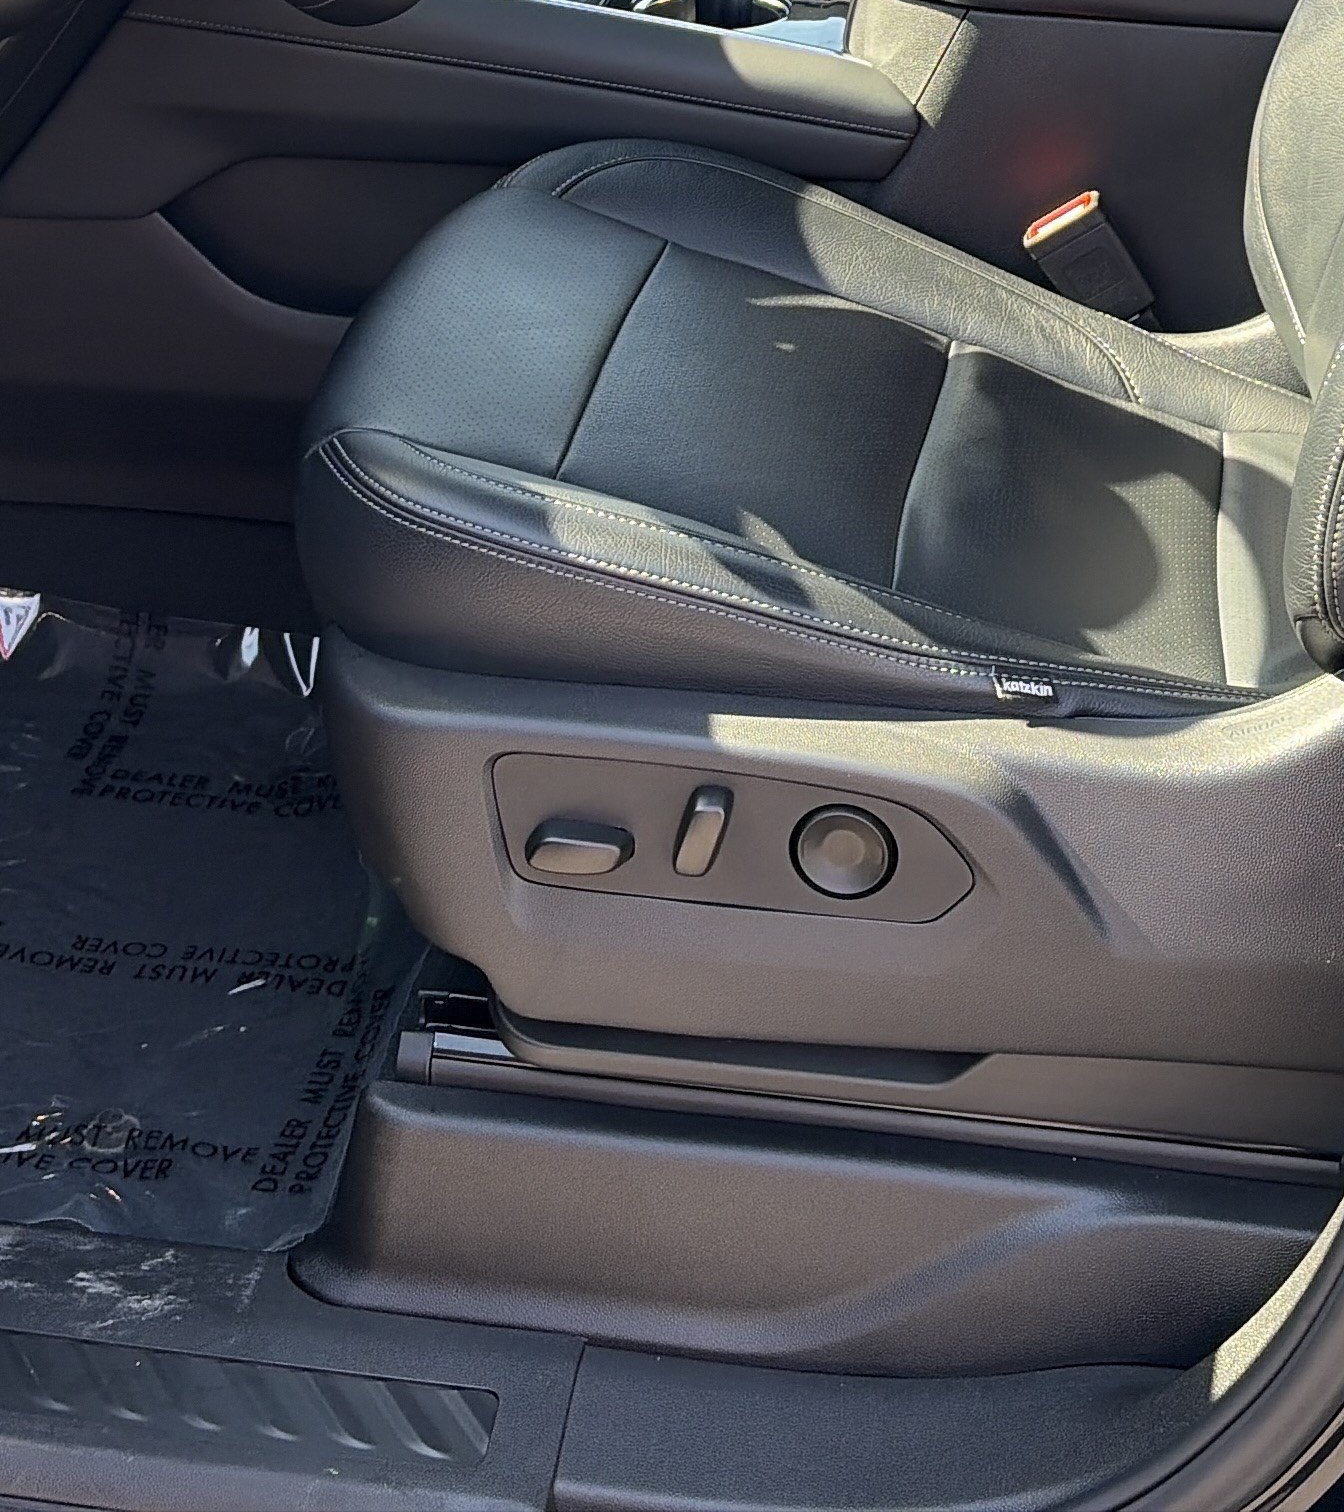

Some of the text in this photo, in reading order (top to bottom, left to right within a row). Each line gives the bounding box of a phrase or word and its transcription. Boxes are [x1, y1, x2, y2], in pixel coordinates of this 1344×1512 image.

[1001, 678, 1054, 697] katzkin
[110, 768, 211, 789] DEALER
[98, 784, 263, 814] PROTECTIVE
[71, 934, 358, 975] PROTECTIVE COVER
[133, 963, 218, 984] MUST
[236, 969, 347, 998] DEALER
[251, 1117, 313, 1194] DEALER
[301, 1048, 345, 1105] MUST
[289, 1068, 367, 1195] PROTECTIVE
[125, 1127, 257, 1163] REMOVE
[67, 1154, 175, 1181] COVER
